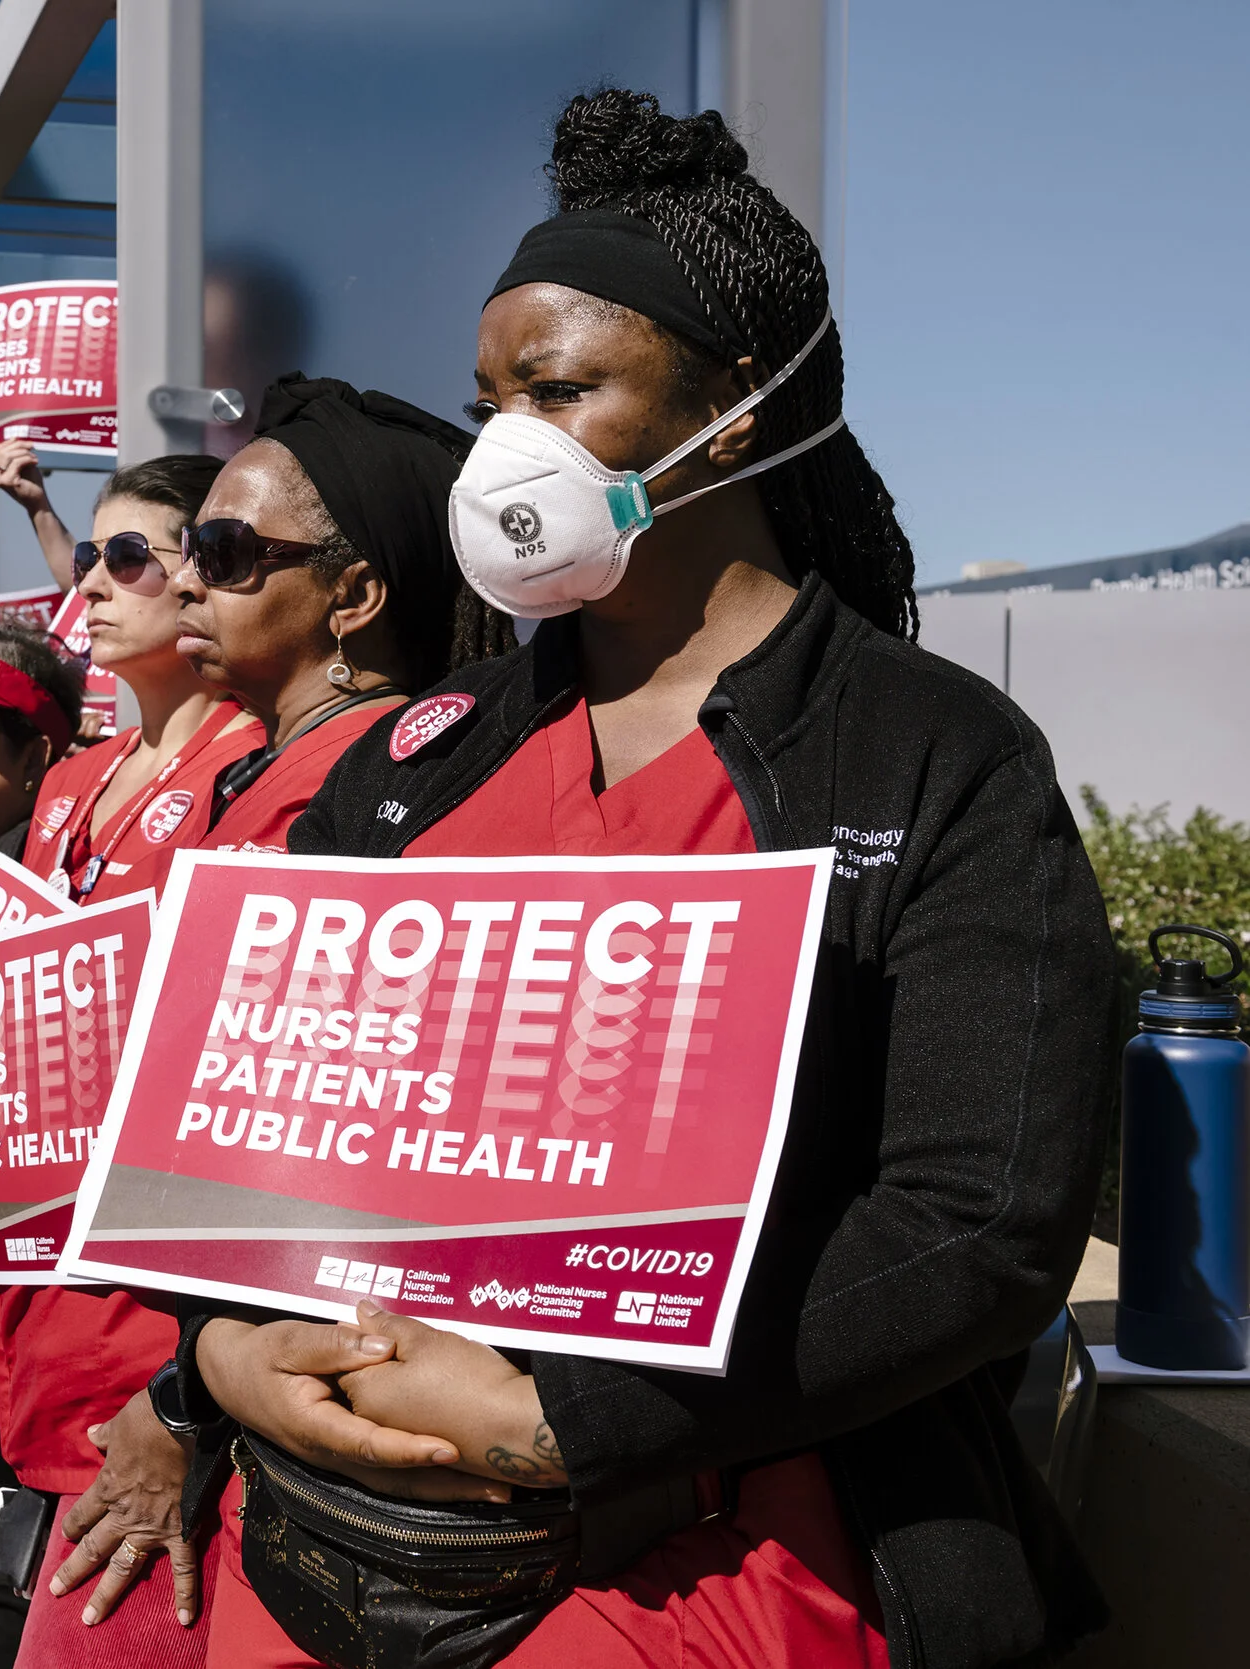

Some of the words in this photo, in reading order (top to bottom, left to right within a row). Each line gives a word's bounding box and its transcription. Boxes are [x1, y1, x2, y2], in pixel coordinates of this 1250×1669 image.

[18, 378, 102, 398] HEALTH
[514, 540, 547, 559] N95
[1157, 562, 1218, 591] Health
[404, 704, 443, 734] YOU
[832, 864, 860, 879] age
[229, 893, 741, 984] PROTECT
[207, 1001, 422, 1056] NURSES
[191, 1051, 455, 1115] PATIENTS
[7, 1124, 103, 1169] HEALTH
[175, 1102, 375, 1165] PUBLIC
[387, 1126, 613, 1187] HEALTH
[564, 1243, 714, 1277] #COVID19
[406, 1270, 451, 1283] California
[404, 1280, 435, 1292] Nurses
[534, 1283, 574, 1296] National
[574, 1287, 607, 1299] Nurses
[401, 1291, 454, 1305] Association
[532, 1294, 584, 1308] Organizing
[659, 1294, 704, 1306] National
[529, 1305, 581, 1319] Committee
[656, 1305, 692, 1317] Nurses
[654, 1315, 688, 1328] United
